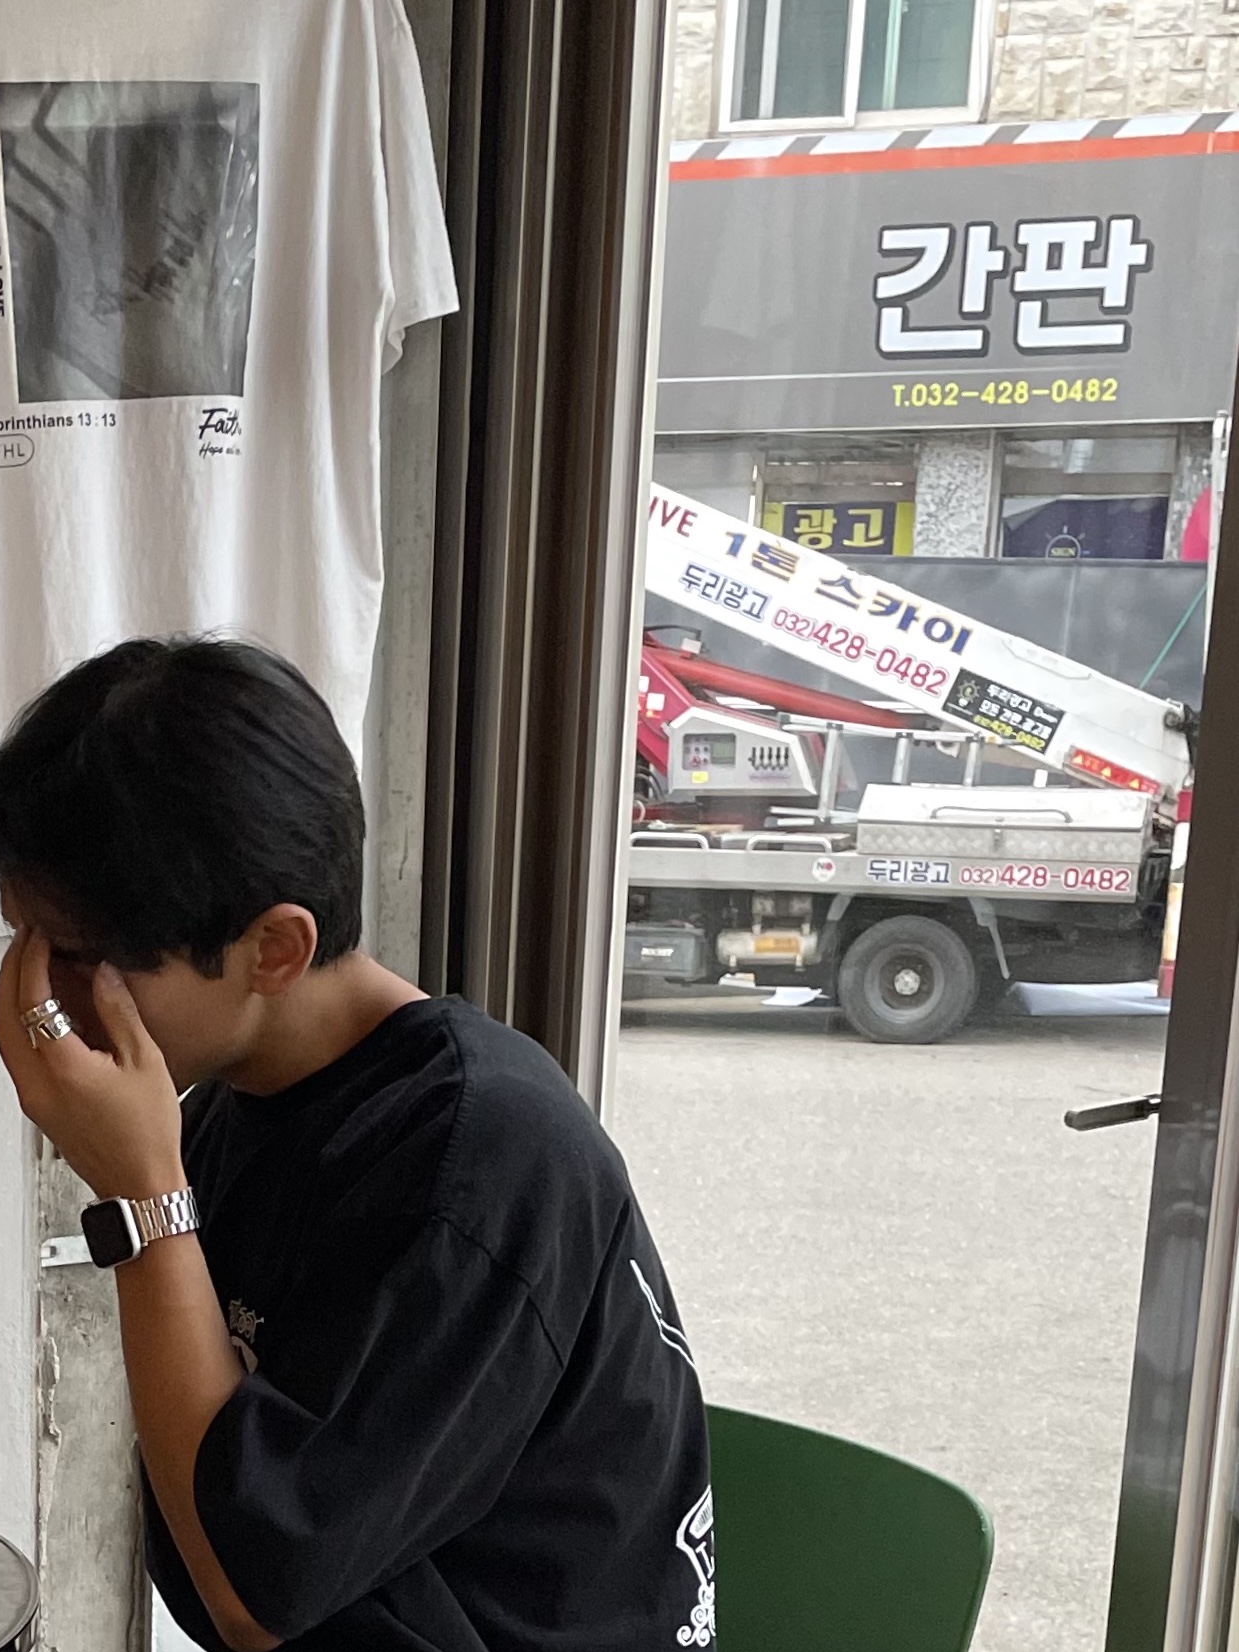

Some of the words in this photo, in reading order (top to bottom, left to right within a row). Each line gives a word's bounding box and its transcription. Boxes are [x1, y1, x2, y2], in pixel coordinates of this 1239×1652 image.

[874, 216, 1151, 356] 간판
[891, 377, 1119, 407] T.032-428-0482
[793, 507, 885, 550] 광고
[681, 563, 772, 620] 두리광고
[772, 608, 949, 697] 032)428-0482
[815, 575, 974, 656] 스카이
[867, 859, 951, 884] 두리광고
[960, 863, 1131, 892] 032)428-0482
